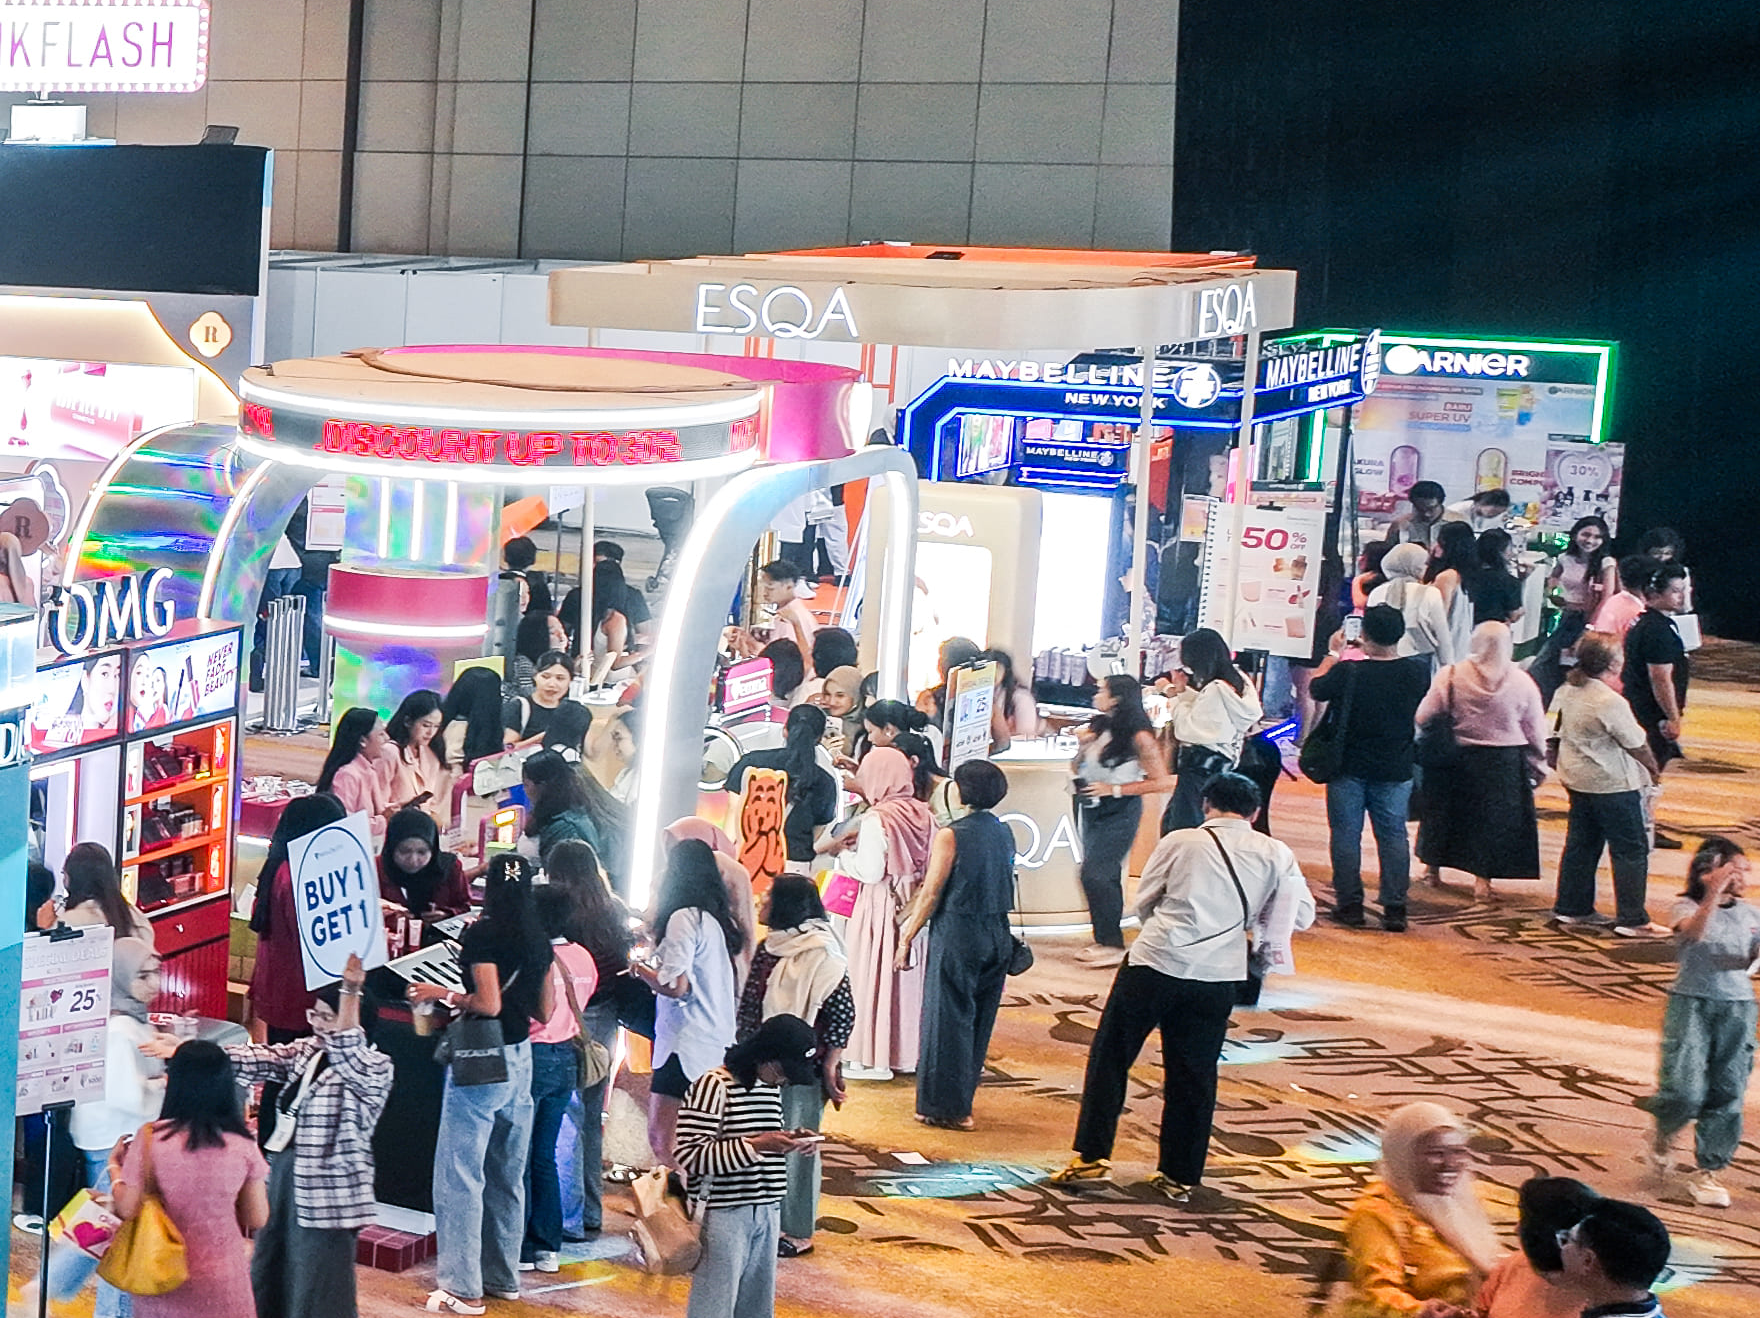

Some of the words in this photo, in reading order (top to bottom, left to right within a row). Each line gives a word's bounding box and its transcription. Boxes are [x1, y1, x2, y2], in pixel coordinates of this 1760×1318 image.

[695, 283, 859, 340] ESQA
[1198, 280, 1258, 340] ESQA
[946, 357, 1172, 390] MAYBELLINE
[1266, 343, 1362, 389] MAYBELLINE
[1065, 391, 1109, 406] NEW
[504, 430, 563, 466] UP
[570, 430, 620, 466] TO
[1026, 446, 1099, 459] MAYBELLINE
[917, 513, 975, 540] SQA
[51, 567, 175, 656] OMG
[1014, 811, 1083, 870] QA
[304, 866, 350, 912] BUY
[354, 861, 364, 891] 1
[310, 904, 354, 947] GET
[358, 899, 369, 929] 1
